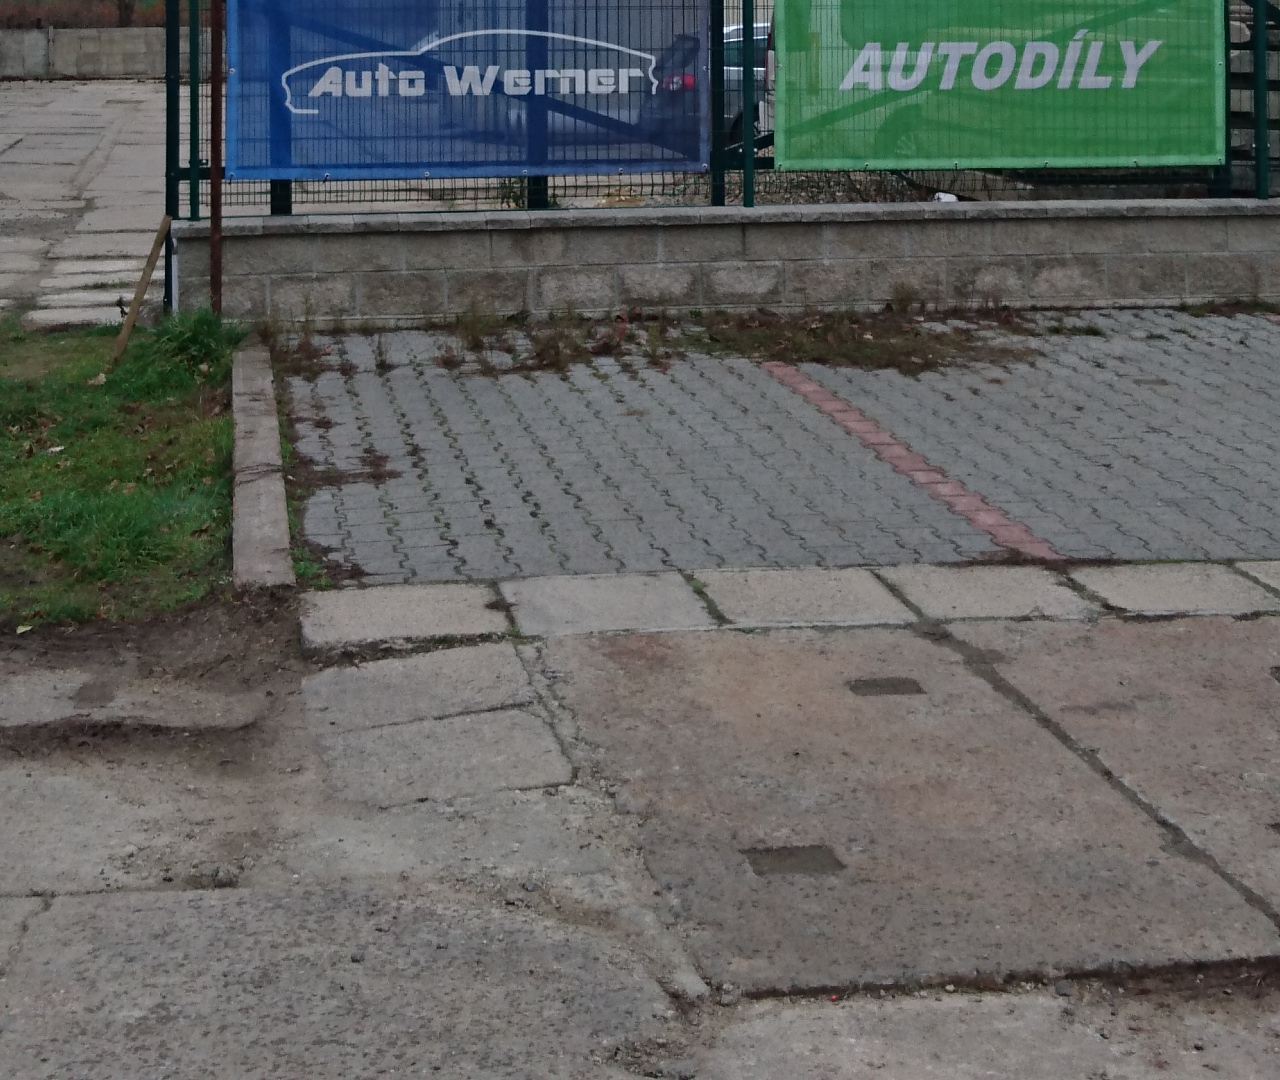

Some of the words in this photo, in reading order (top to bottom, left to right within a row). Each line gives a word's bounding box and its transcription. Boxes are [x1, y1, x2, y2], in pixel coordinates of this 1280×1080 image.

[308, 62, 425, 97] Auto
[444, 64, 644, 96] Werner
[839, 29, 1162, 90] AUTODÍLY
